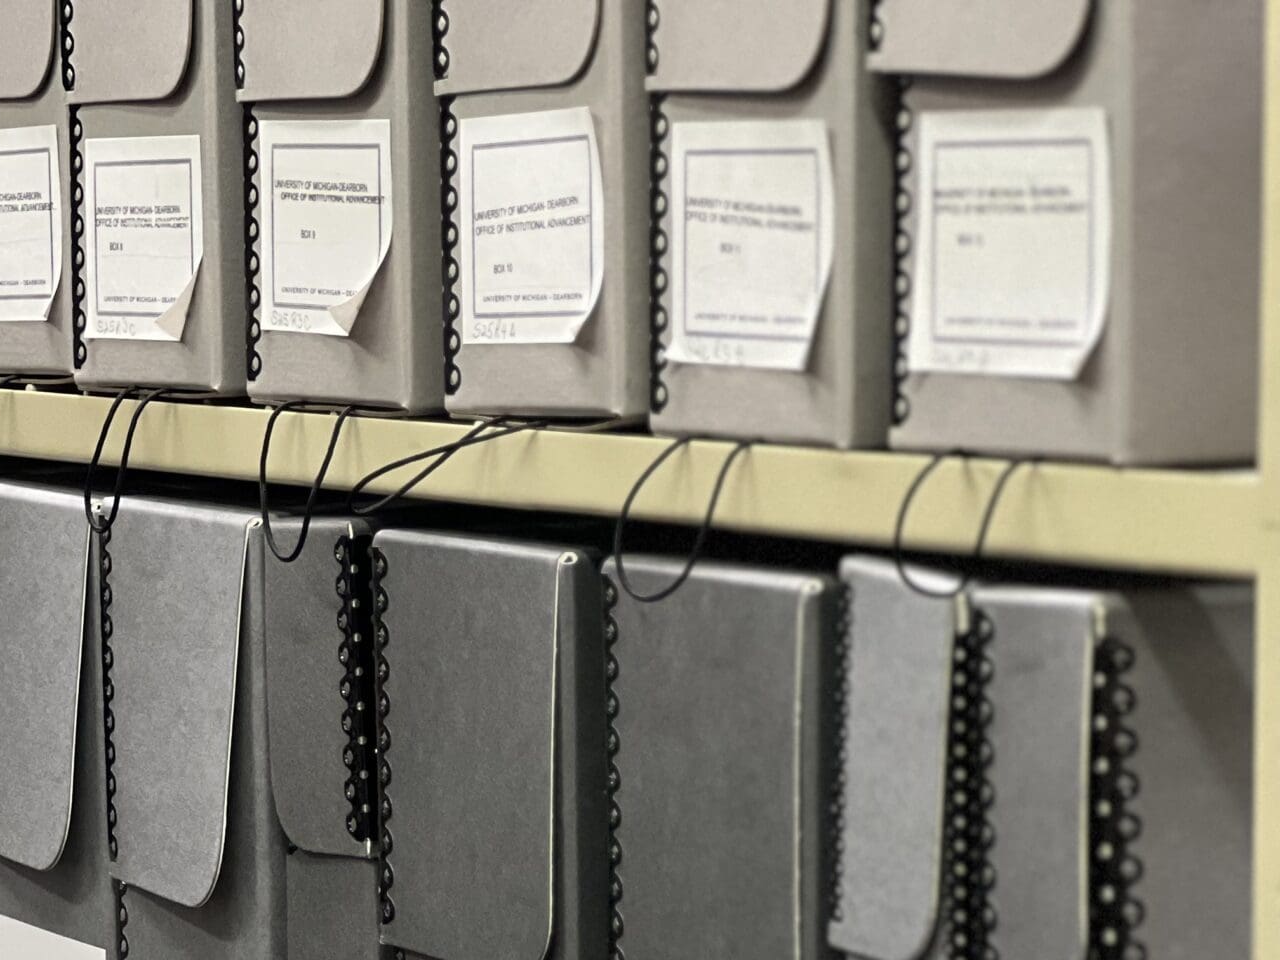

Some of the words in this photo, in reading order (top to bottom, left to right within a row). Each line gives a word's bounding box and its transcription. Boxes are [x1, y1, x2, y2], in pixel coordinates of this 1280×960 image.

[275, 180, 303, 189] UNIVERSITY
[280, 192, 299, 201] OFFICE
[474, 207, 506, 221] UNIVERSITY
[508, 205, 516, 216] OF
[475, 225, 495, 236] OFFICE
[497, 223, 504, 234] OF
[505, 220, 545, 233] INSTITUTIONAL
[493, 264, 505, 274] BOX
